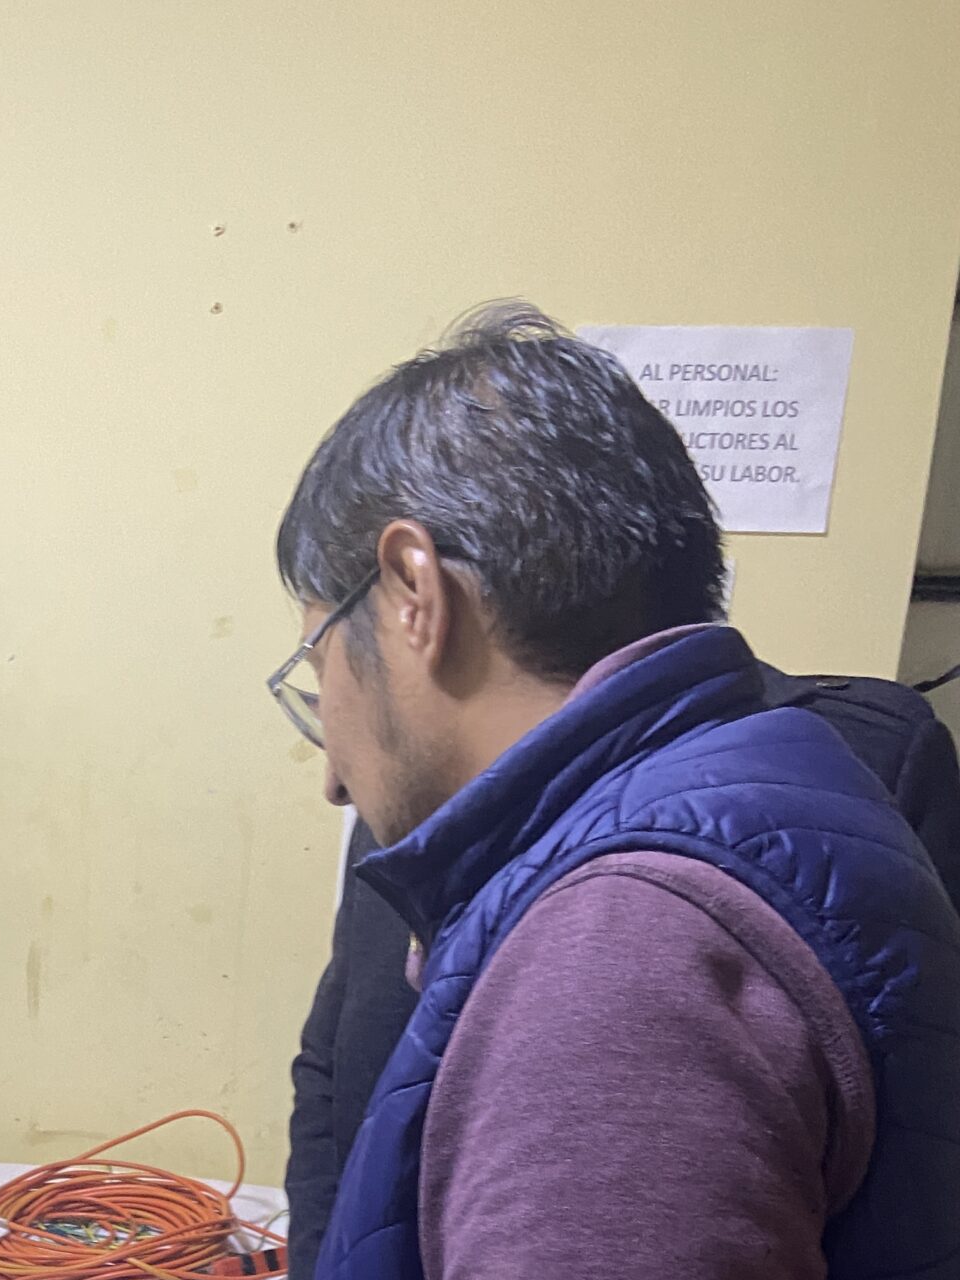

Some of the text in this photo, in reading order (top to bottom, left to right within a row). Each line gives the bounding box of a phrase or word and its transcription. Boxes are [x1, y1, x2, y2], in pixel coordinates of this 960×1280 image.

[640, 364, 779, 383] AL PERSONAL:
[675, 399, 757, 418] LIMPIOS
[761, 400, 800, 418] LOS
[684, 432, 799, 451] UCTORES AL
[700, 464, 801, 483] SU LABOR.
